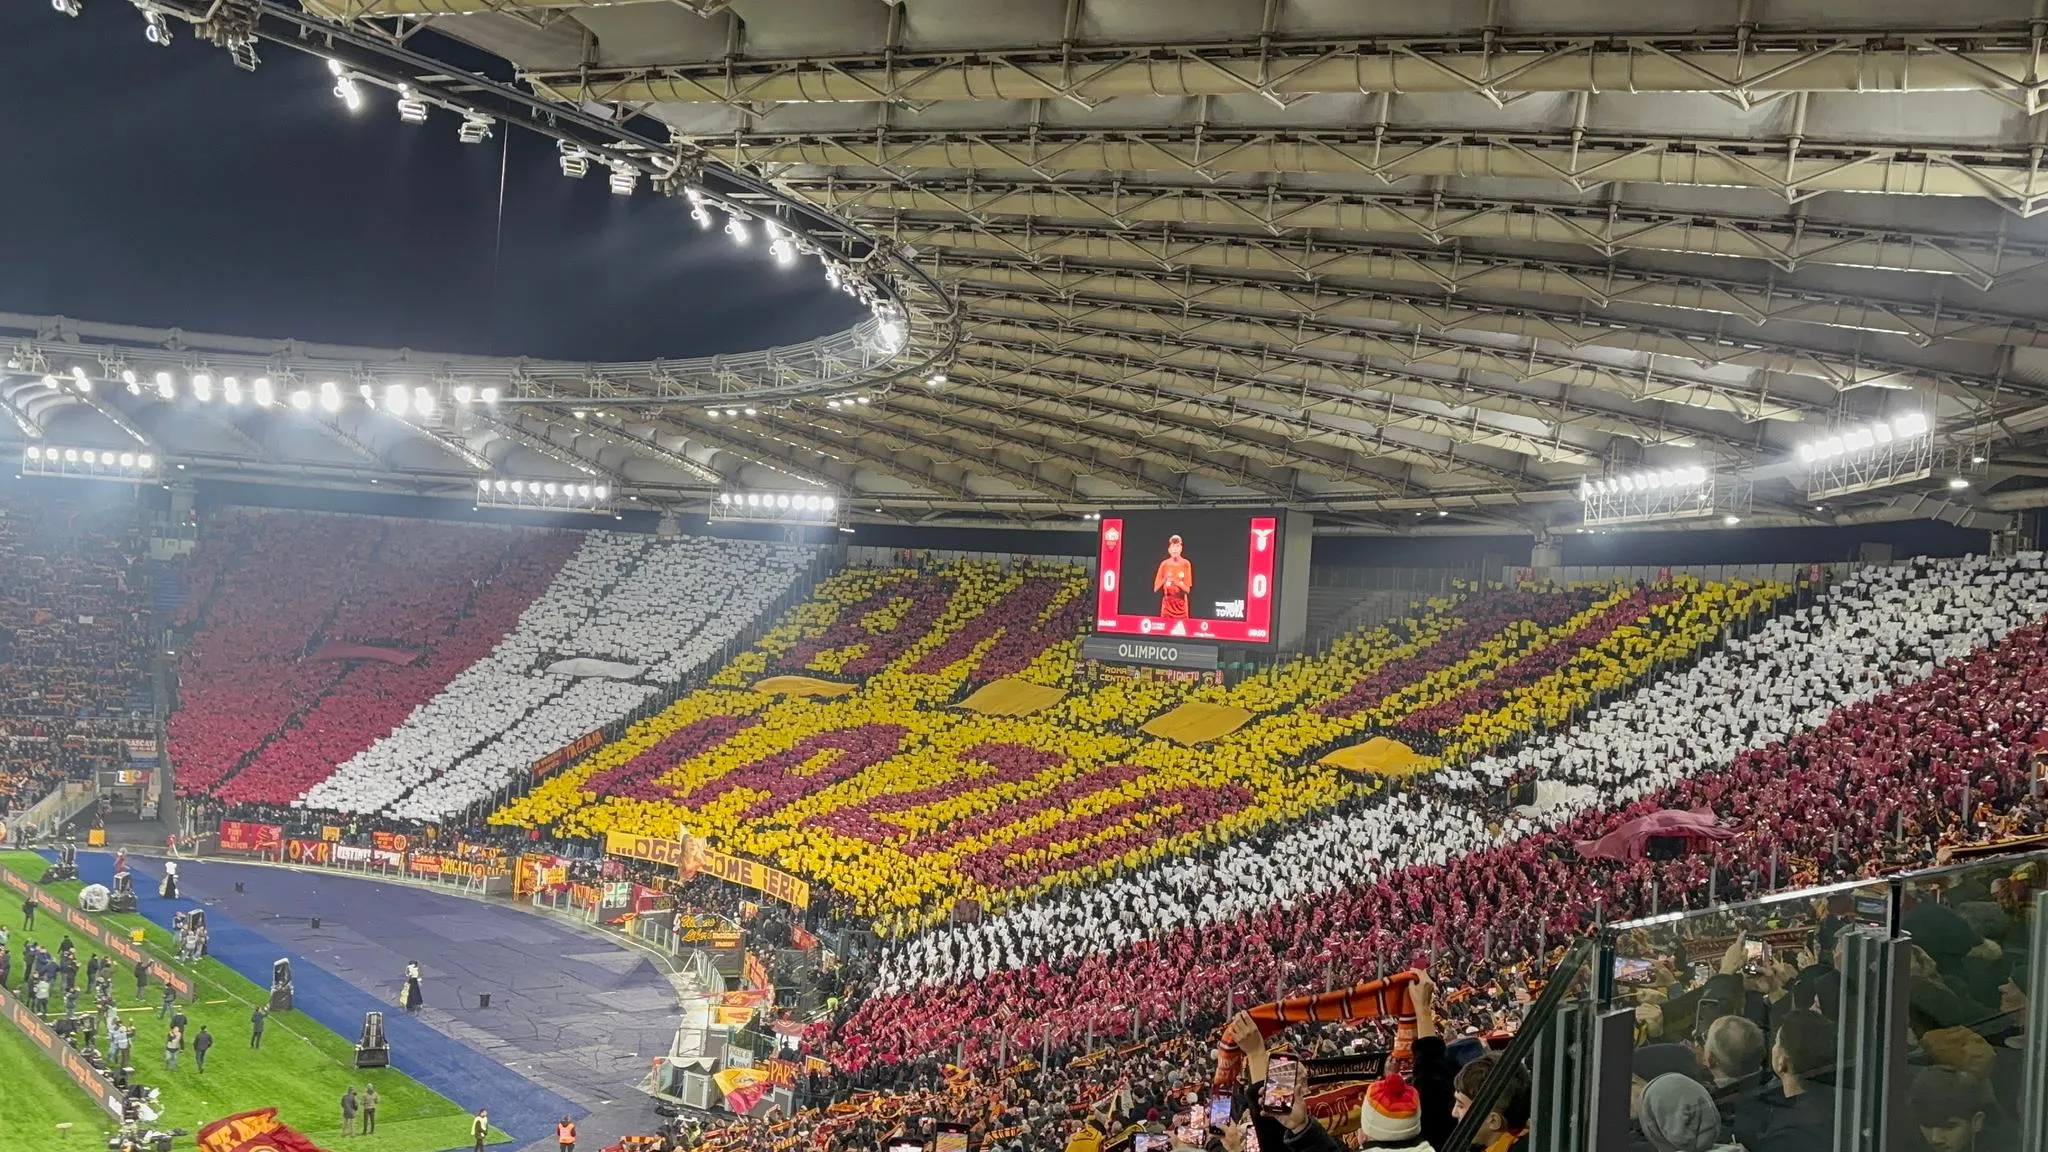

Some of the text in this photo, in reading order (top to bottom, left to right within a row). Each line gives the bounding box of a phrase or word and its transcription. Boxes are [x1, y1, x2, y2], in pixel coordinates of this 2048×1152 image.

[1103, 569, 1116, 592] 0
[1252, 574, 1267, 599] 0
[1215, 608, 1244, 618] TOYOTA
[1118, 644, 1178, 662] OLIMPICO
[1104, 666, 1128, 674] ROMA
[615, 838, 681, 864] ...OGG
[703, 849, 753, 885] COME
